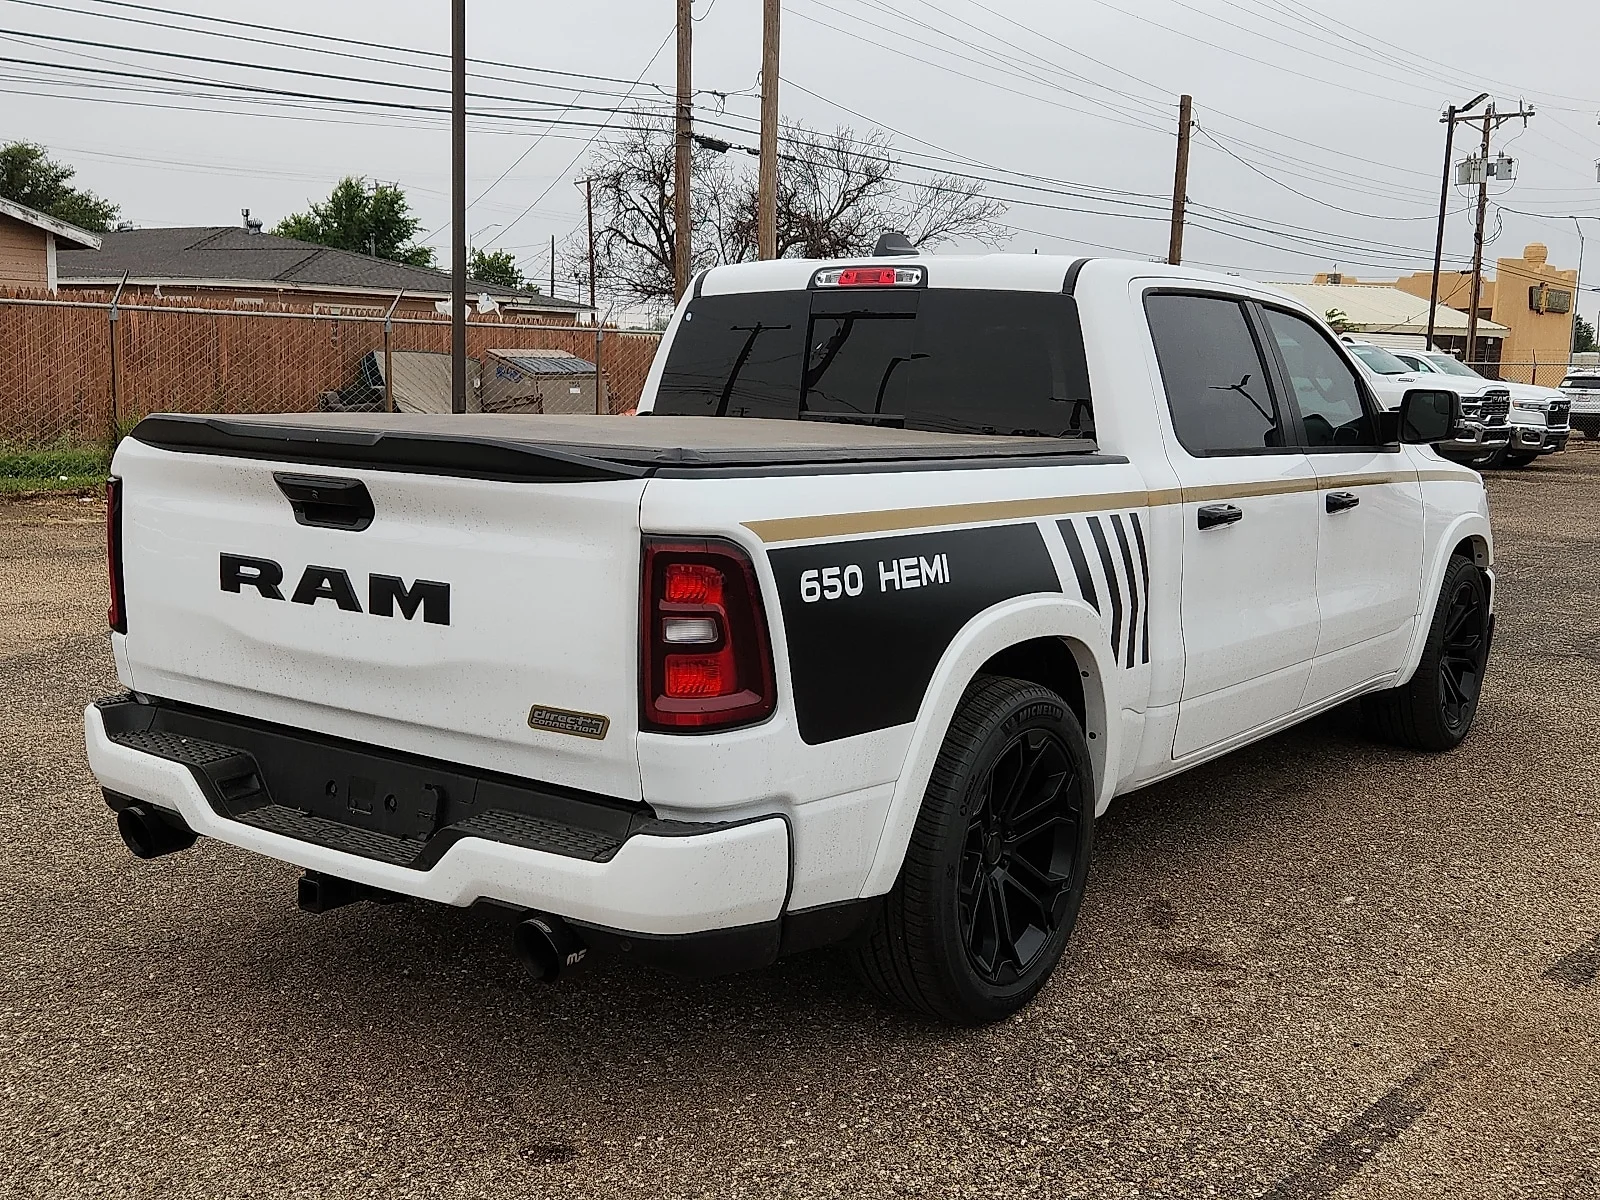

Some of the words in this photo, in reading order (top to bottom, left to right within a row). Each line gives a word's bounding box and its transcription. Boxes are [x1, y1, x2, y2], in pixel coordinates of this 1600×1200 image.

[800, 564, 864, 603] 650
[878, 553, 950, 592] HEMI
[220, 552, 451, 626] RAM
[533, 710, 591, 726] direct
[1019, 704, 1063, 722] MICHELIN
[531, 717, 603, 734] connection
